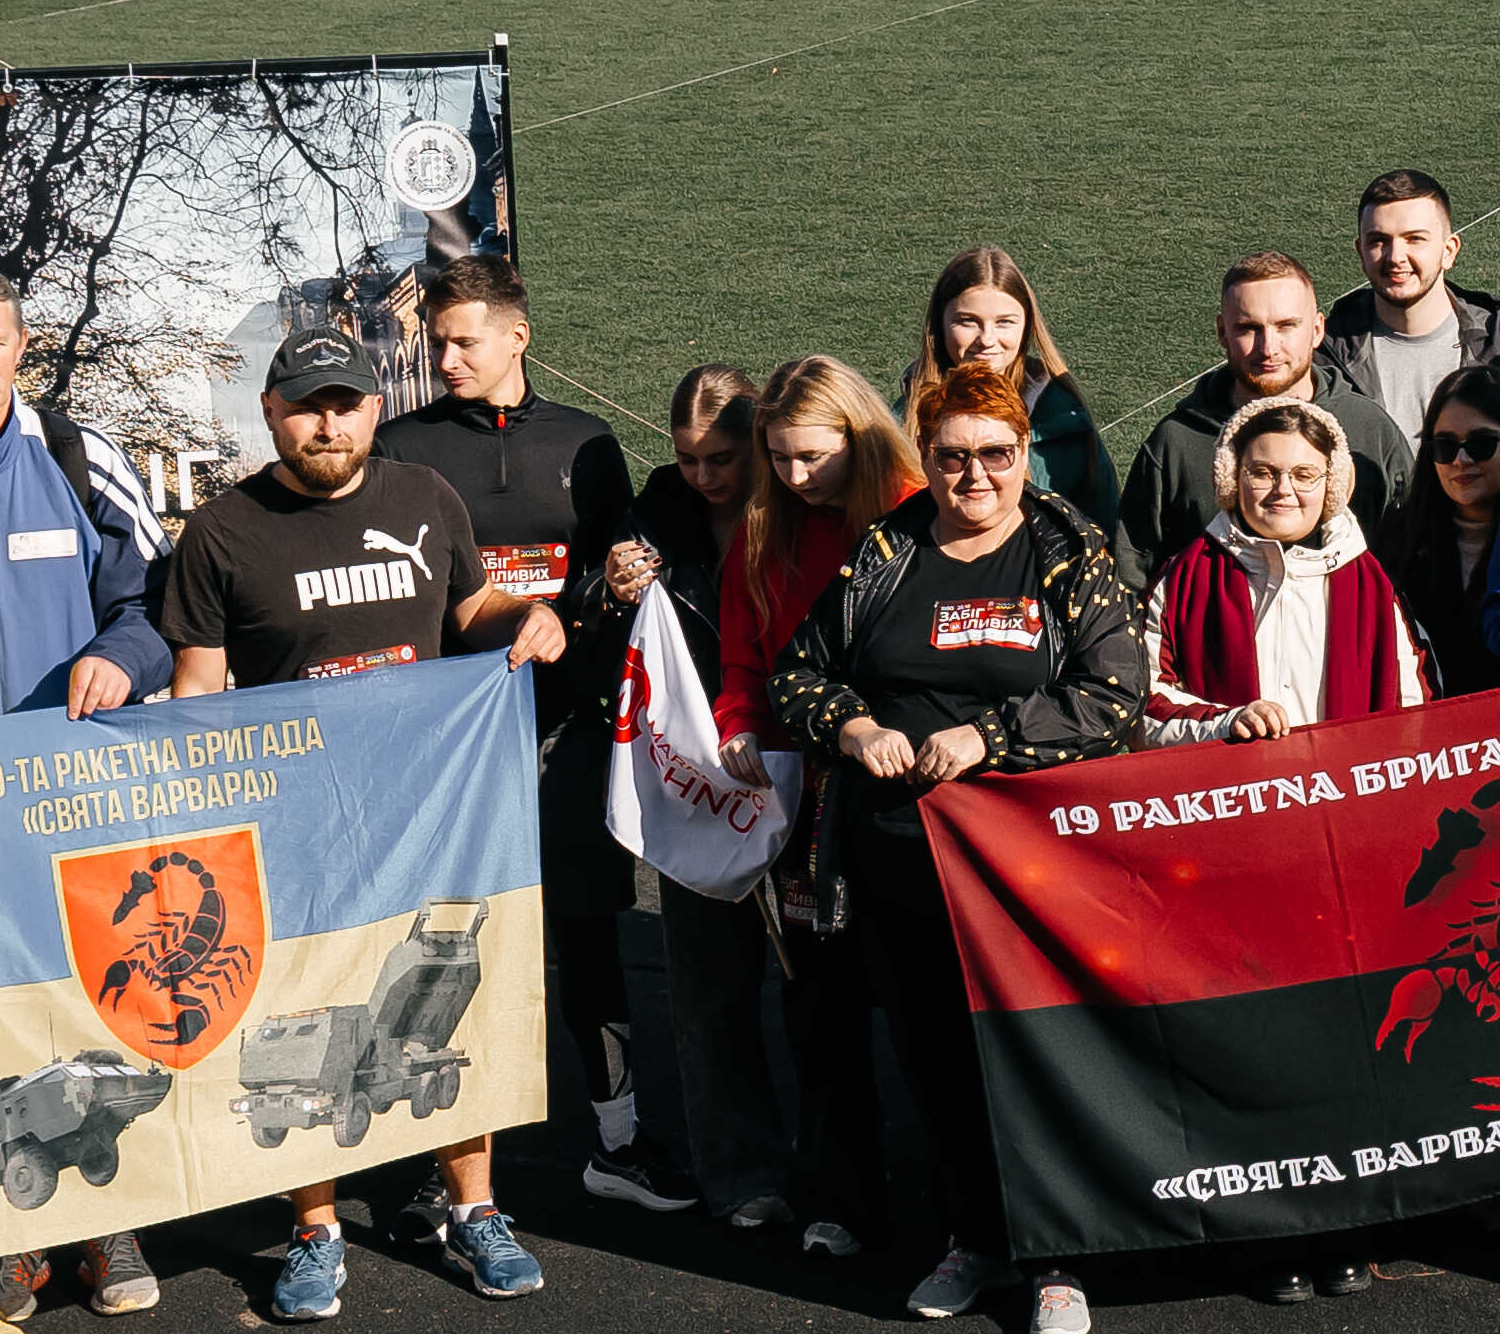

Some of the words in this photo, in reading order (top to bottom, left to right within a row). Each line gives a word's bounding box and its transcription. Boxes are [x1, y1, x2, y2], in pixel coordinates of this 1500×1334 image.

[149, 449, 220, 514] ІГ
[295, 559, 417, 611] PUMA
[491, 568, 550, 583] ІЛИВИХ
[939, 607, 986, 622] ЗАБІГ
[56, 738, 181, 789] РАКЕТНА
[185, 717, 325, 769] БРИГАДА
[22, 790, 126, 836] «СВЯТА
[130, 770, 279, 819] ВАРВАРА»
[1049, 804, 1100, 837] 19
[1152, 1154, 1347, 1203] «СВЯТА
